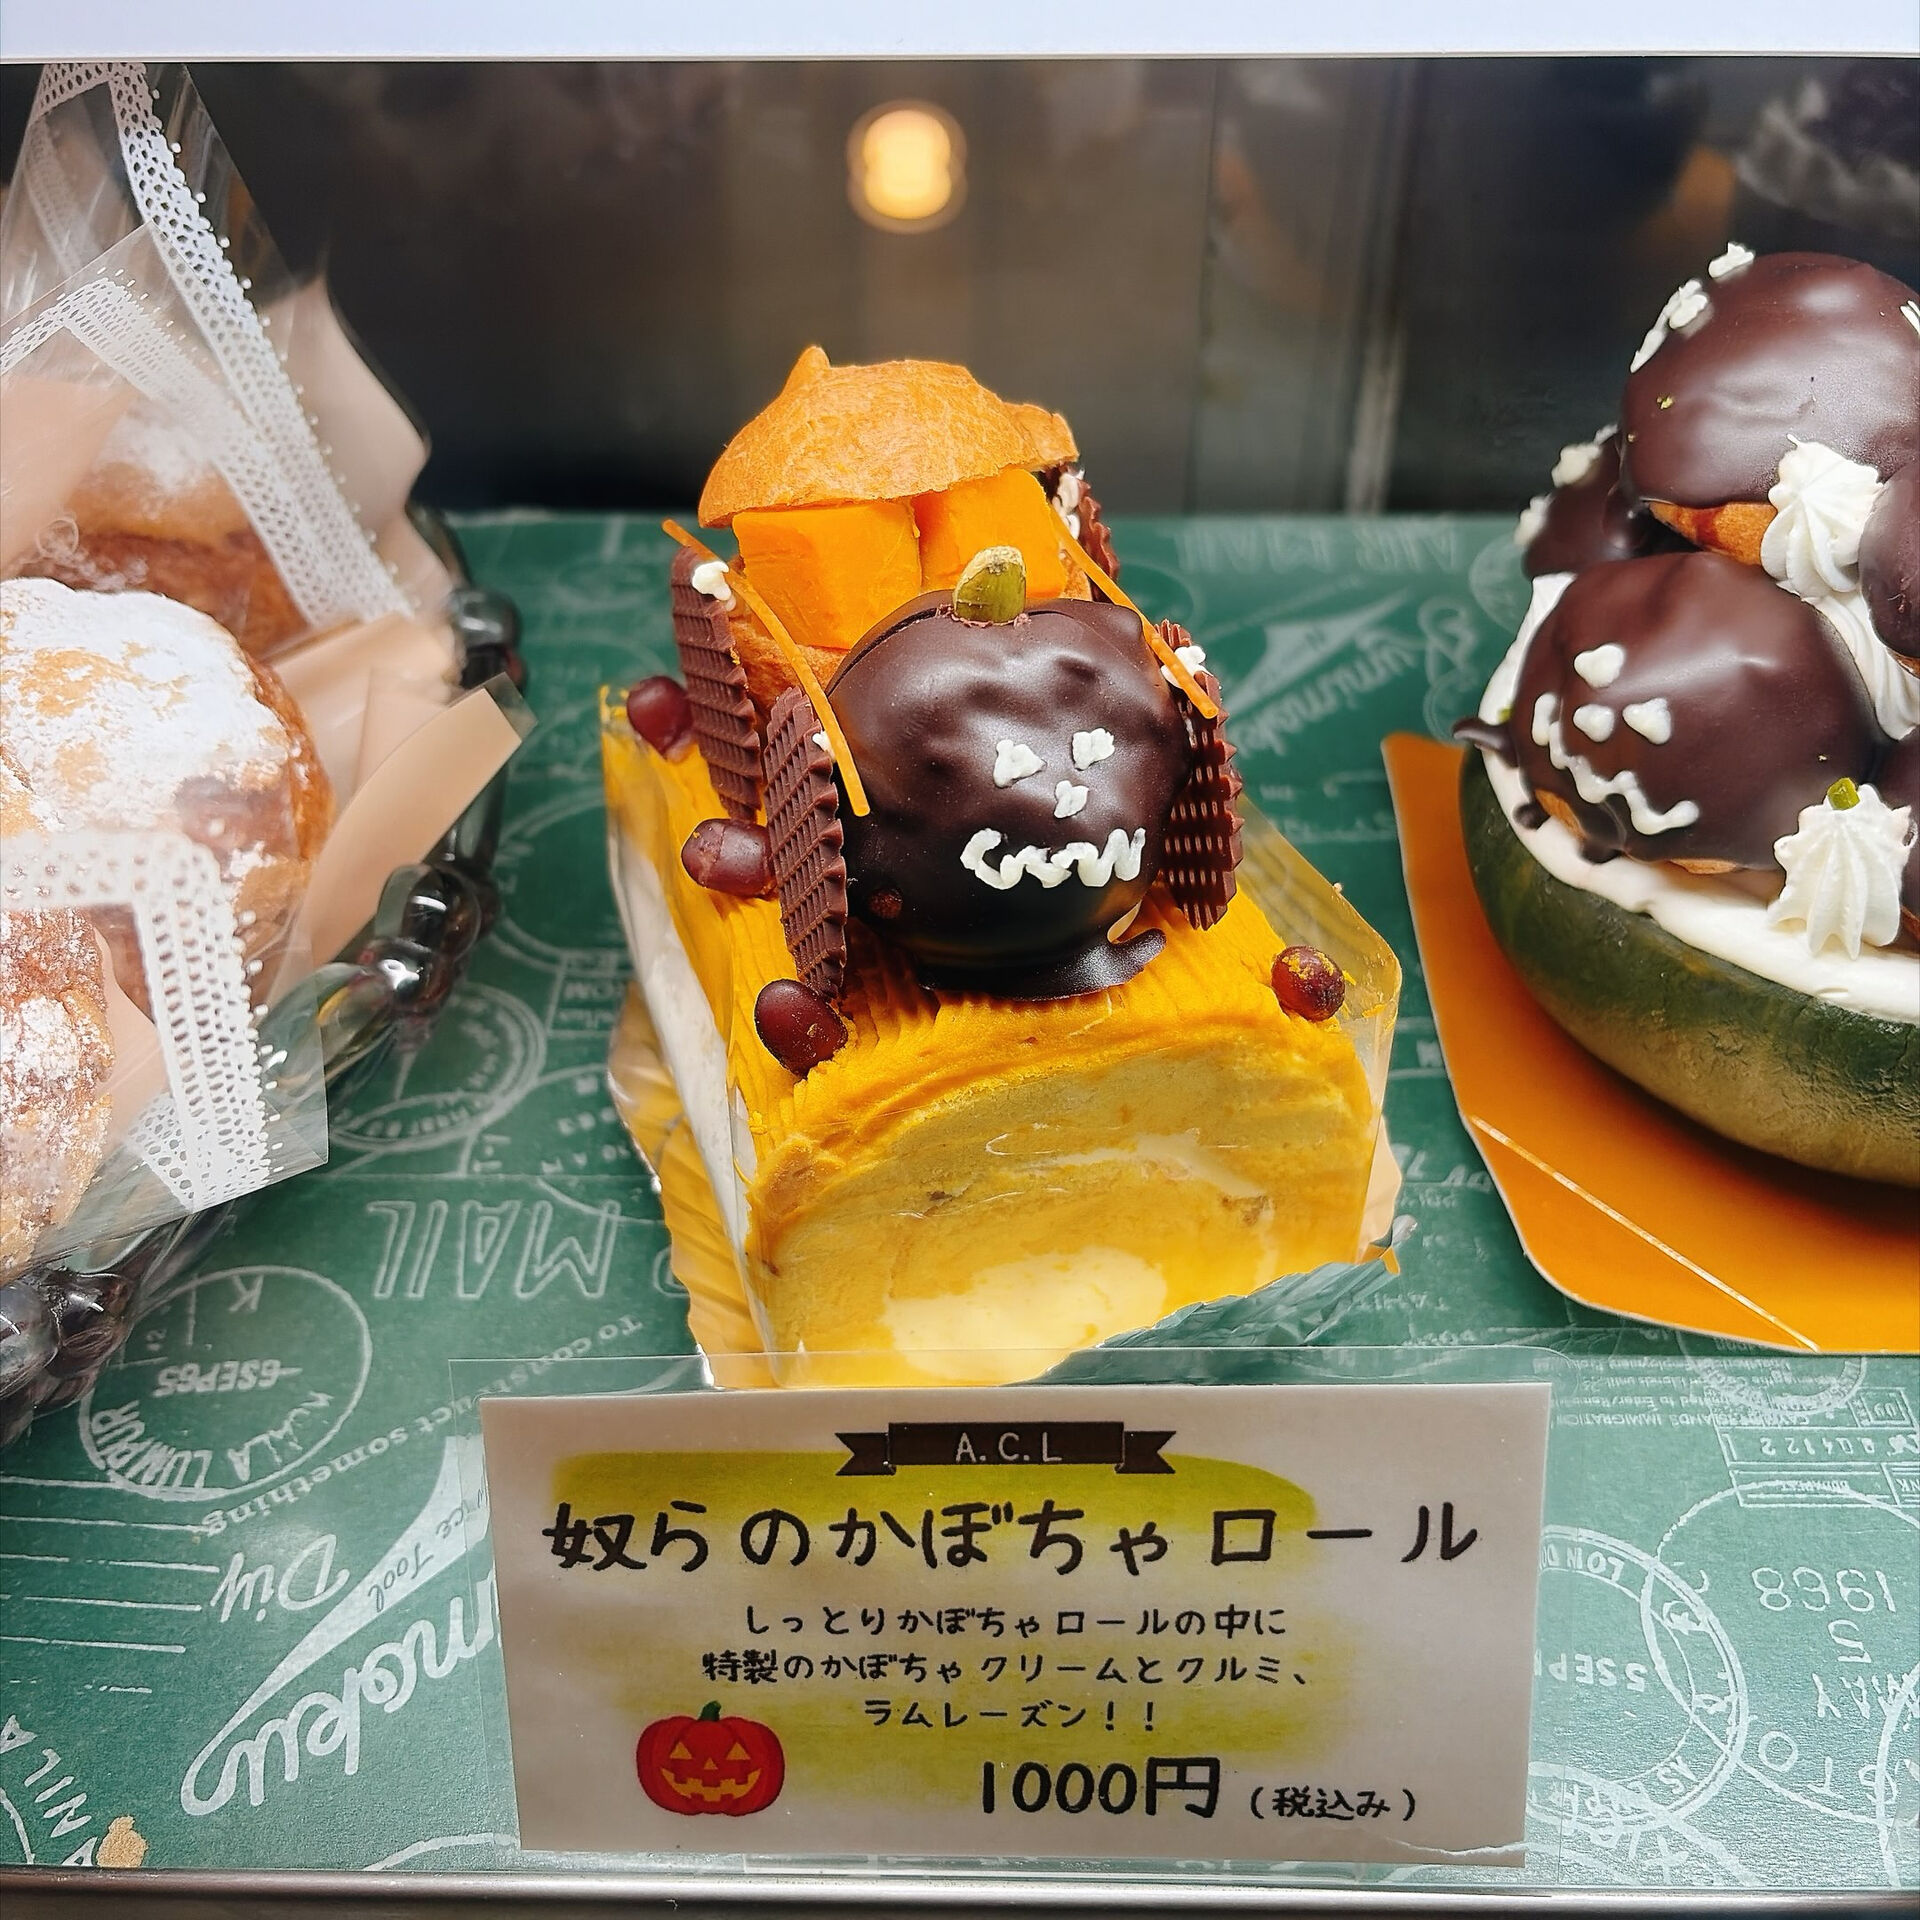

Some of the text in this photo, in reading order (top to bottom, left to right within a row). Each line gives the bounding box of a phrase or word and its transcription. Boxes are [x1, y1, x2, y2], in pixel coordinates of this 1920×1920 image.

[366, 1199, 623, 1300] MAIL
[542, 1499, 1478, 1576] 奴らのかぼちゃロール
[747, 1604, 1287, 1639] しっとりかぼちゃロールの中に
[702, 1649, 1307, 1685] 特製のかぼちゃクリームとクルミ、
[982, 1756, 1221, 1818] 1000円
